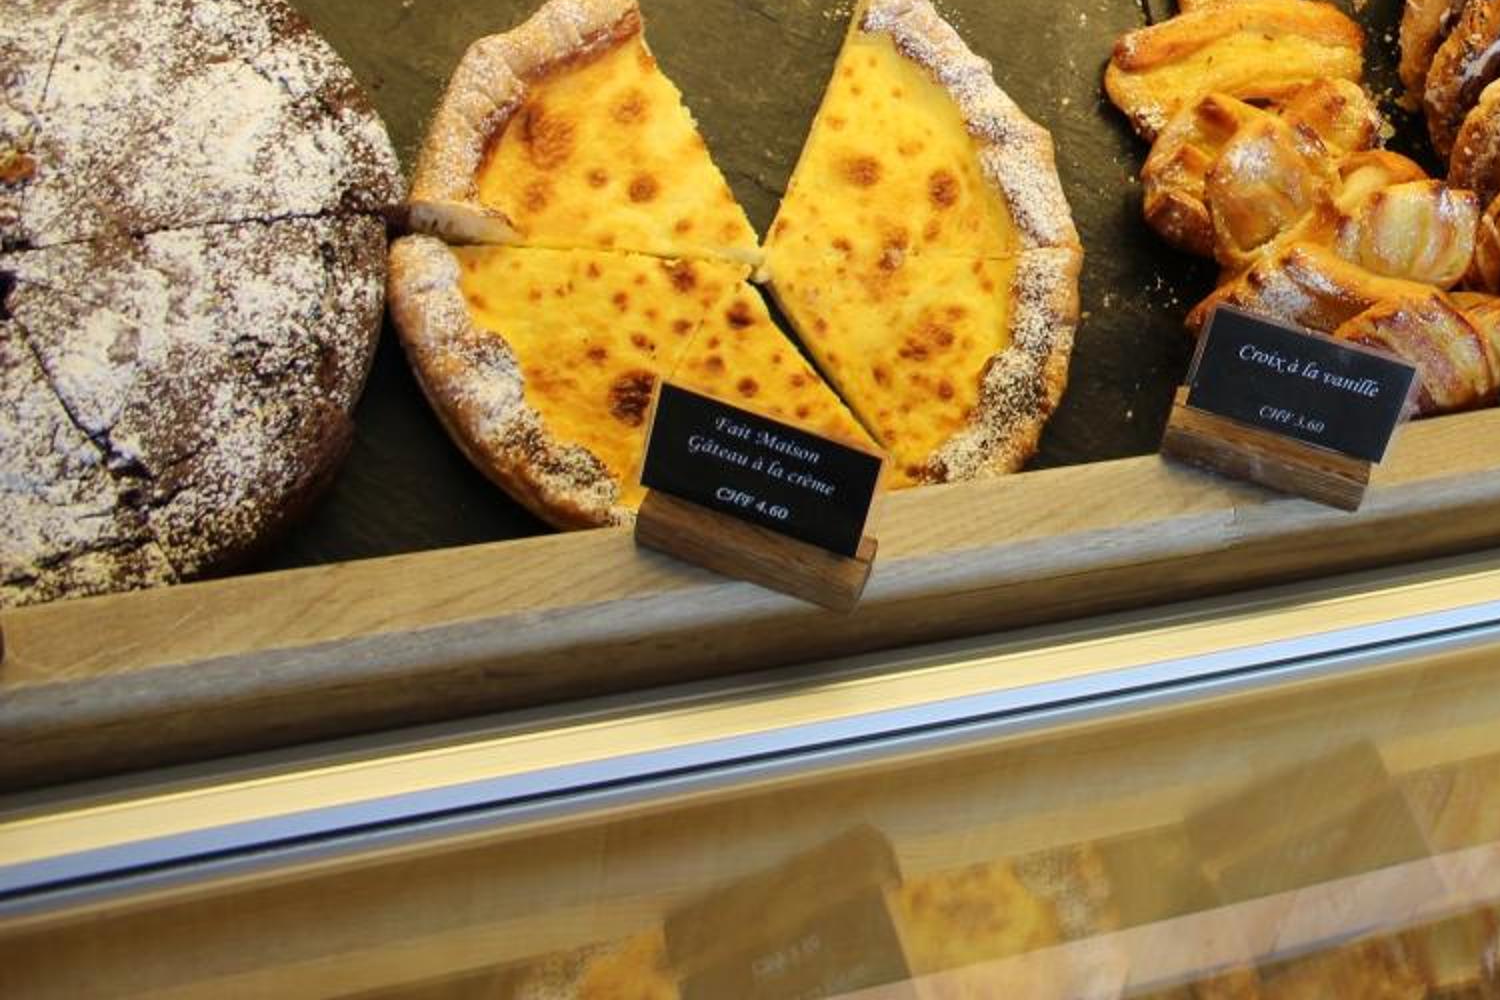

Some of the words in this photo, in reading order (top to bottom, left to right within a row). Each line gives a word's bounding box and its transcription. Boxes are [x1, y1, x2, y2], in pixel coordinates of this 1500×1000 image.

[1239, 343, 1286, 373] Croix
[1287, 359, 1299, 374] à
[1301, 361, 1320, 379] la
[1323, 371, 1380, 398] vanille
[1258, 404, 1295, 424] CHF
[687, 434, 748, 465] Gâteau
[751, 454, 765, 473] à
[767, 458, 786, 479] la
[715, 415, 751, 440] Fait
[755, 430, 821, 464] Maison
[715, 486, 755, 508] CHF
[755, 497, 790, 521] 4.60
